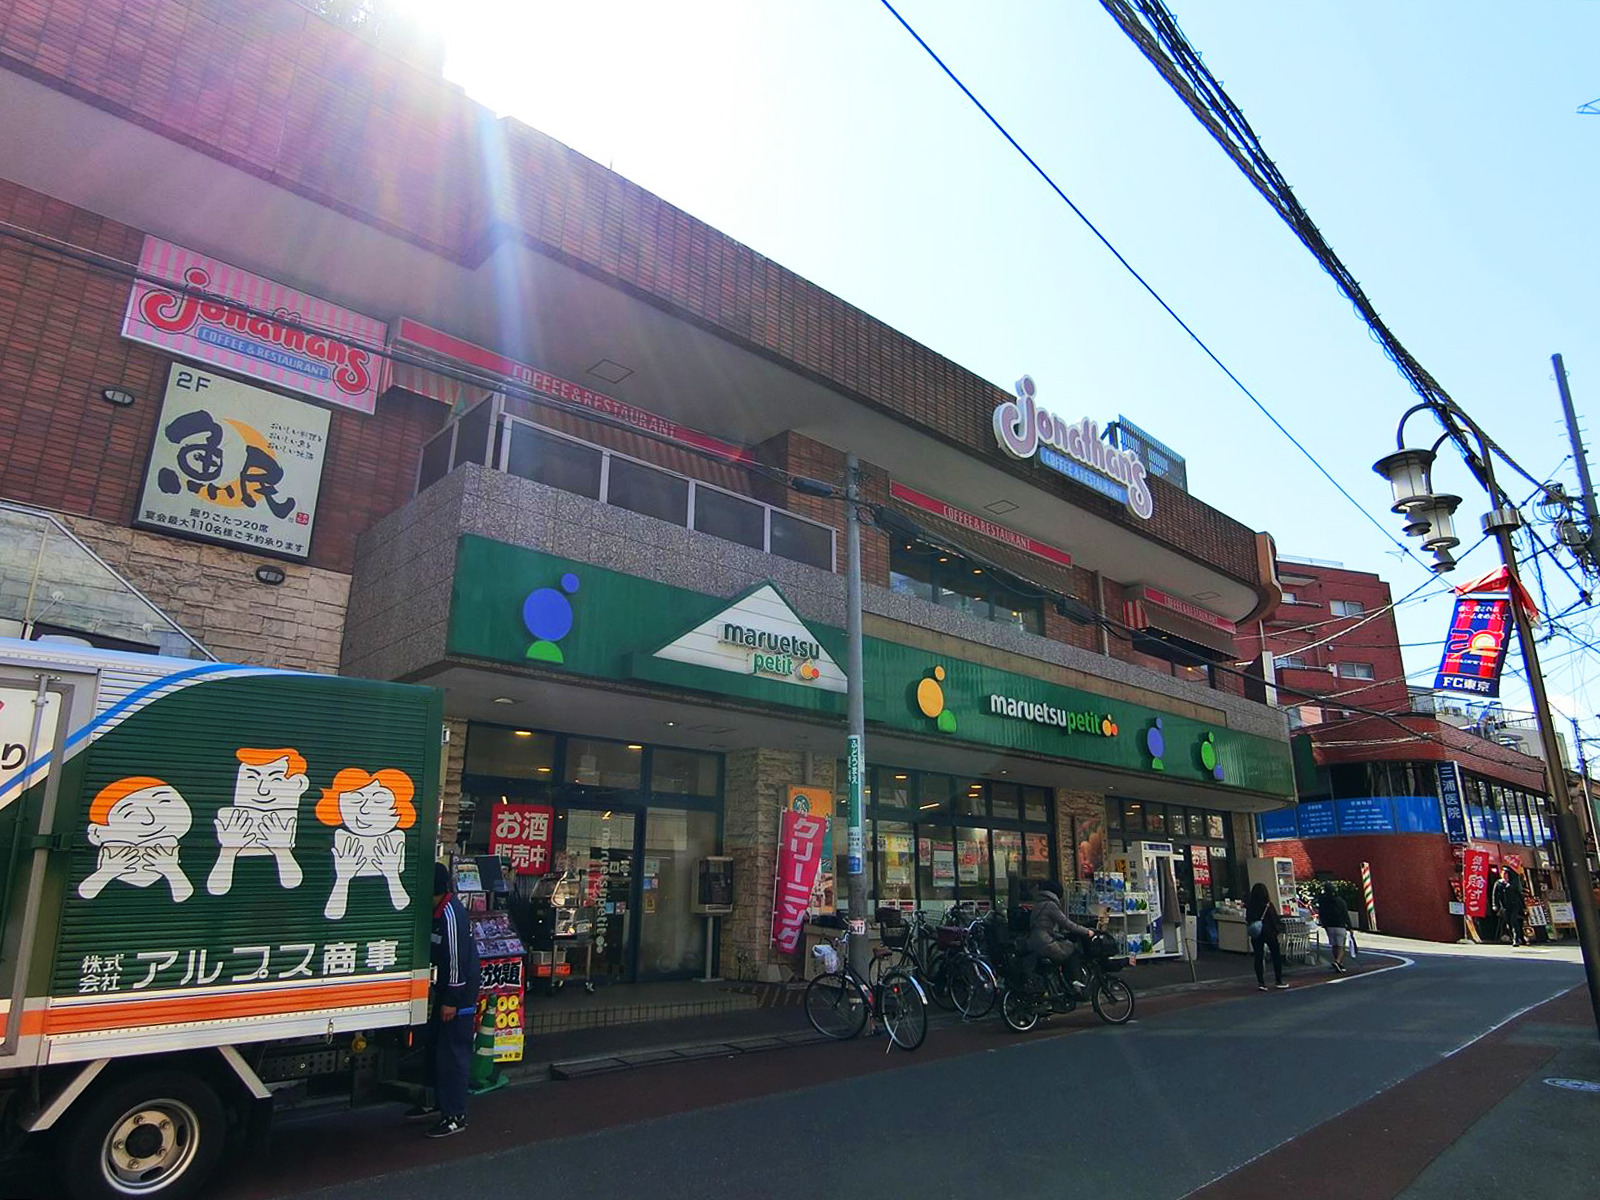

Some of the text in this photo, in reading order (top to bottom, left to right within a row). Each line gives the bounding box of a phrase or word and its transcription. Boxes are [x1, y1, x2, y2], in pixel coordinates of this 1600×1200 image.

[202, 327, 247, 356] COFFEE
[257, 345, 325, 377] RESTAURANT
[176, 371, 211, 393] 2F
[512, 364, 569, 399] COFFEE
[584, 391, 678, 439] RESTAURANT
[157, 409, 296, 519] 魚民
[190, 507, 269, 534] 掘りこたつ20席
[723, 622, 820, 660] maruetsu
[753, 652, 792, 676] petit
[1442, 676, 1491, 692] FC東京
[1440, 766, 1462, 819] 三浦医院
[495, 811, 549, 842] お酒
[494, 844, 548, 869] 販売中
[81, 953, 125, 974] 株式
[132, 939, 400, 990] アルプス商事
[78, 974, 122, 993] 会社
